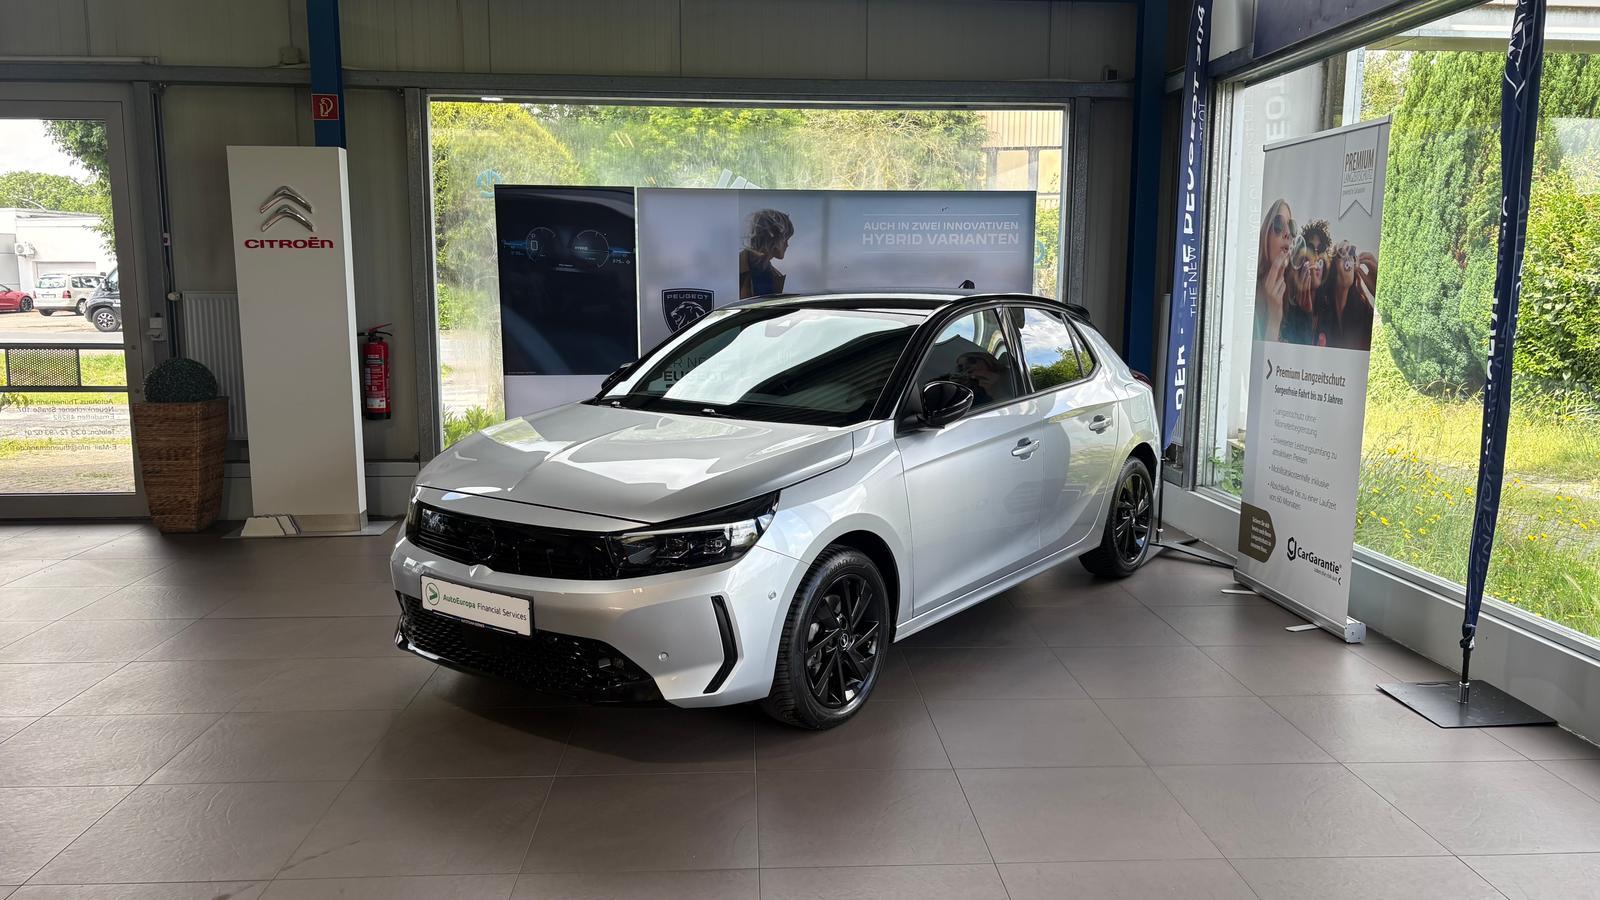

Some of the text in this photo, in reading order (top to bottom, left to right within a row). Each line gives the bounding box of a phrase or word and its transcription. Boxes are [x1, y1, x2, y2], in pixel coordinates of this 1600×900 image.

[1344, 148, 1375, 172] PREMIUM
[863, 221, 1019, 231] AUCH IN ZWEI INNOVATIVEN
[244, 236, 334, 249] CITROËN
[862, 233, 1019, 246] HYBRID VARIANTEN
[1187, 245, 1198, 318] THE NEW
[1276, 365, 1346, 387] Premium Langzeitschutz
[1274, 384, 1298, 397] Sorgenfreie
[1298, 388, 1310, 399] Fahrt
[1317, 394, 1323, 402] zu
[1323, 393, 1327, 402] 5
[1327, 394, 1344, 405] Jahren
[1297, 547, 1341, 575] CarGarantie
[443, 594, 527, 621] AutoEuropa Financial Services
